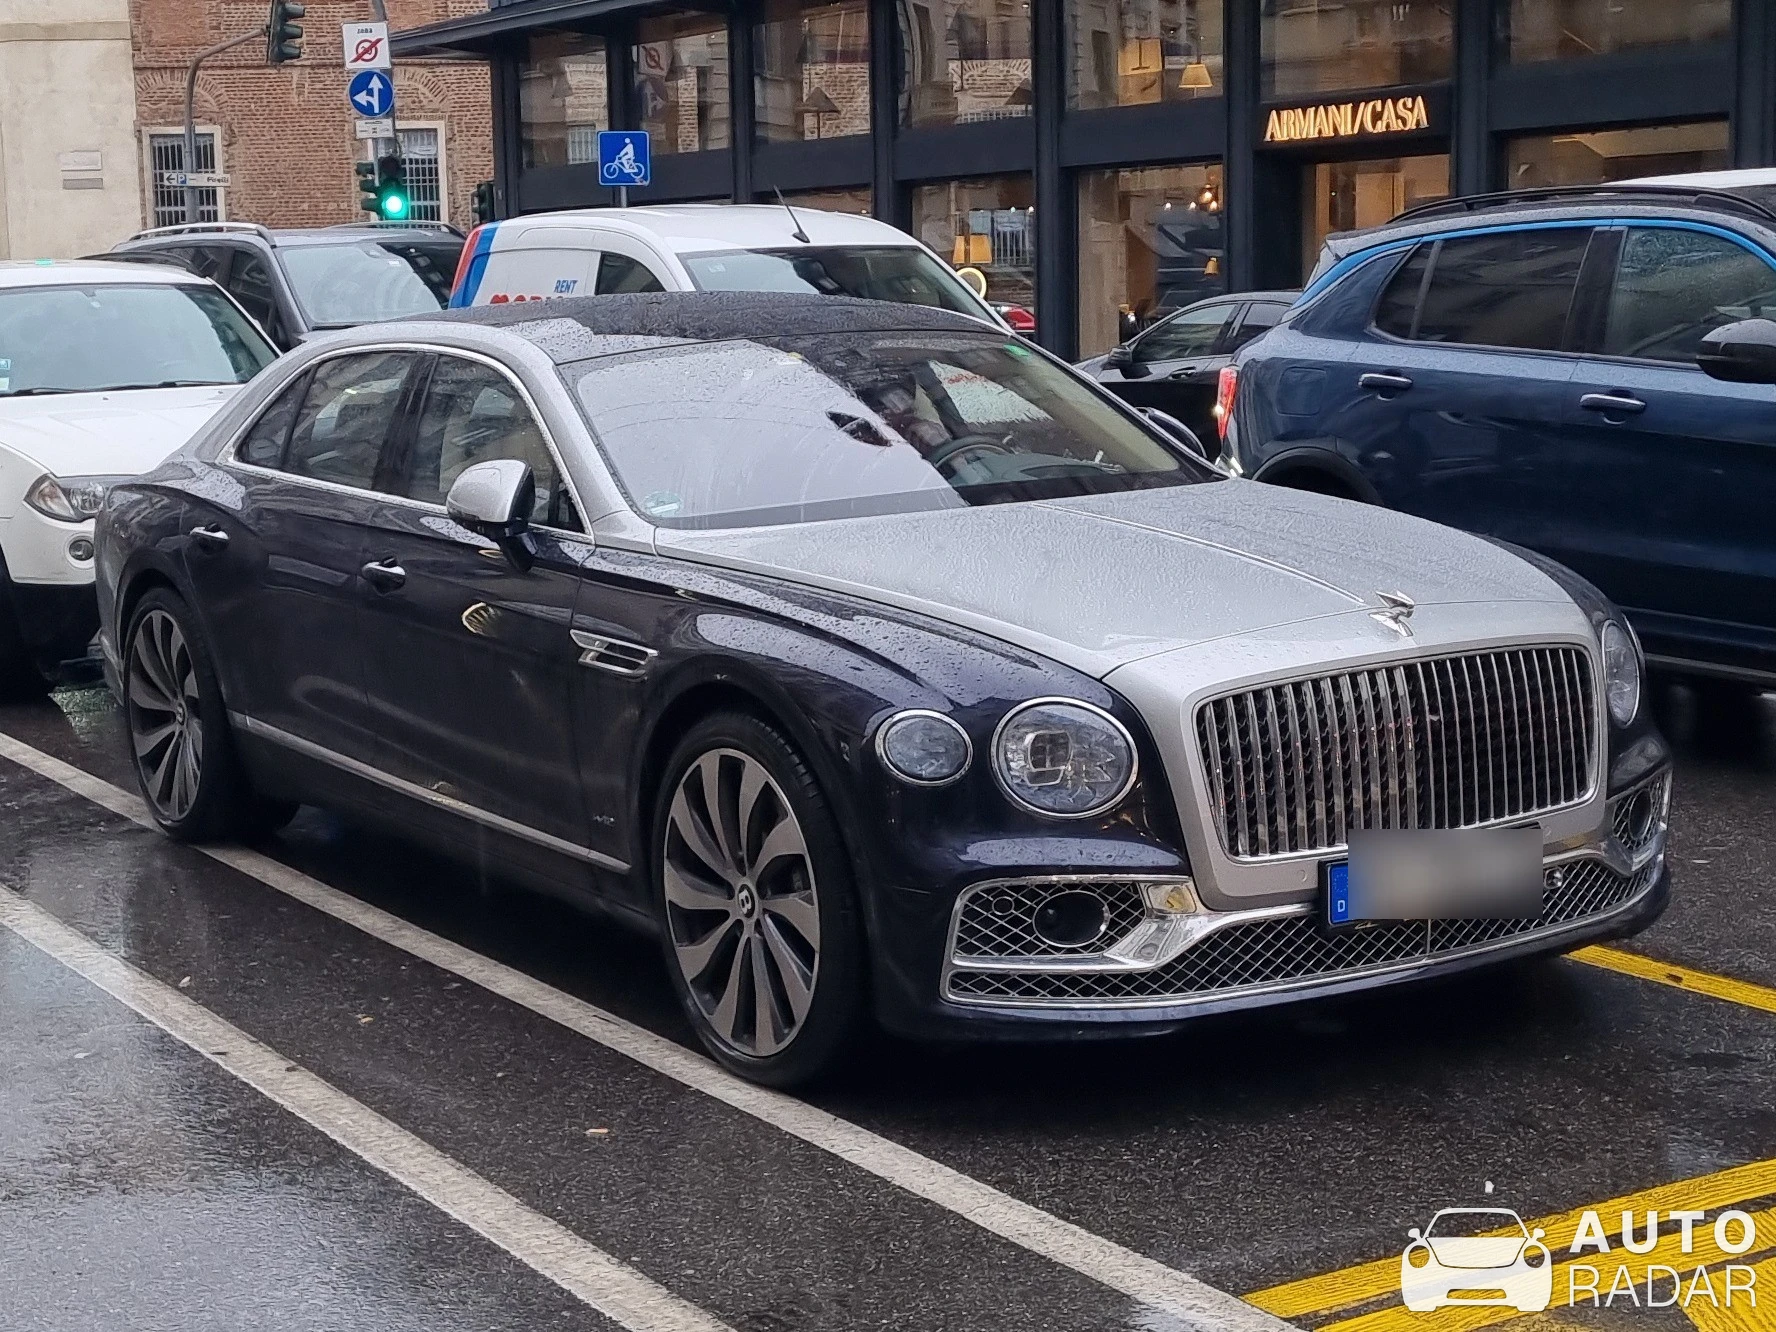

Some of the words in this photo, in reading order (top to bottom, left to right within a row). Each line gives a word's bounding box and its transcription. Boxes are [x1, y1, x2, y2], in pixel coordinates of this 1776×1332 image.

[1263, 95, 1430, 142] ARMANI/CASA
[554, 279, 578, 294] RENT
[1337, 899, 1346, 913] D
